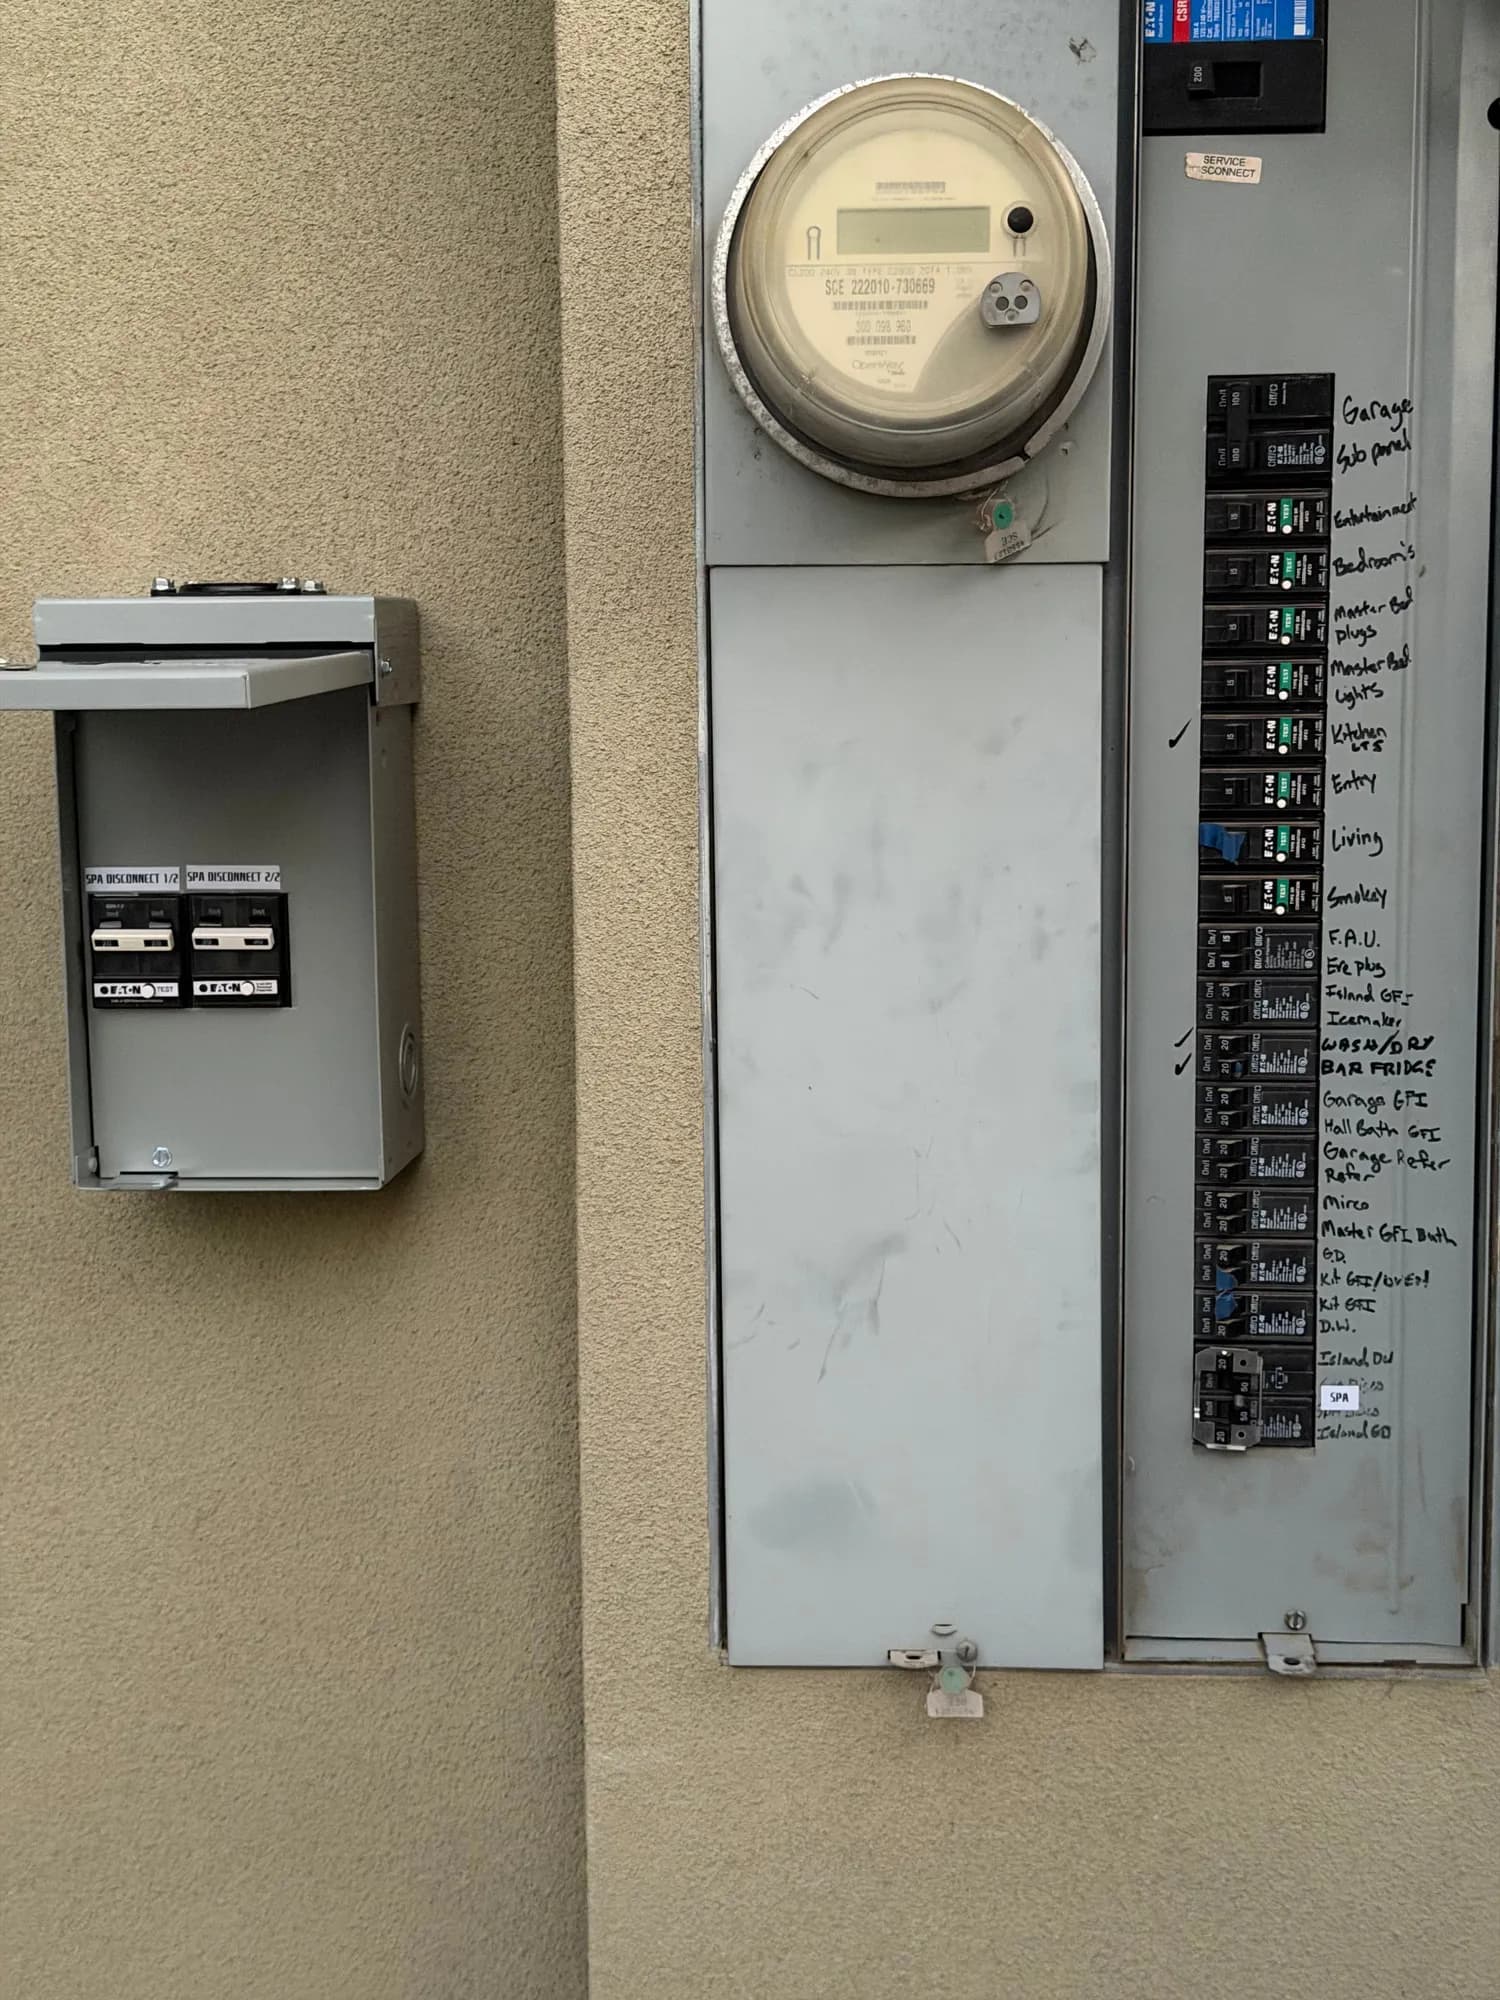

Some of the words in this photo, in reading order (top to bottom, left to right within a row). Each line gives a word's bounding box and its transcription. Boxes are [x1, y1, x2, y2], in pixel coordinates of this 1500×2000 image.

[1203, 155, 1246, 167] SERVICE
[825, 279, 844, 295] SCE
[851, 278, 935, 295] 222010-730669
[1343, 395, 1414, 432] Garage
[1337, 443, 1367, 474] Sub
[1334, 601, 1386, 622] Master
[1389, 586, 1414, 615] Bed
[1330, 657, 1385, 677] Master
[1331, 770, 1376, 794] Entry
[1332, 826, 1384, 857] Living
[86, 875, 103, 885] SPA
[106, 873, 159, 884] DISCONNECT
[164, 874, 178, 884] 1/2
[187, 872, 205, 882] SPA
[208, 872, 261, 882] DISCONNECT
[265, 872, 280, 882] 2/2
[1329, 929, 1380, 948] F.A.U.
[1327, 1010, 1402, 1028] Icemaker
[1321, 1059, 1363, 1077] BAR
[1370, 1059, 1437, 1077] FRIDGE
[1324, 1119, 1351, 1135] Hall
[1356, 1119, 1399, 1137] Bath
[1408, 1125, 1441, 1142] GFI
[1324, 1141, 1392, 1173] Garage
[1330, 1392, 1349, 1402] SPA
